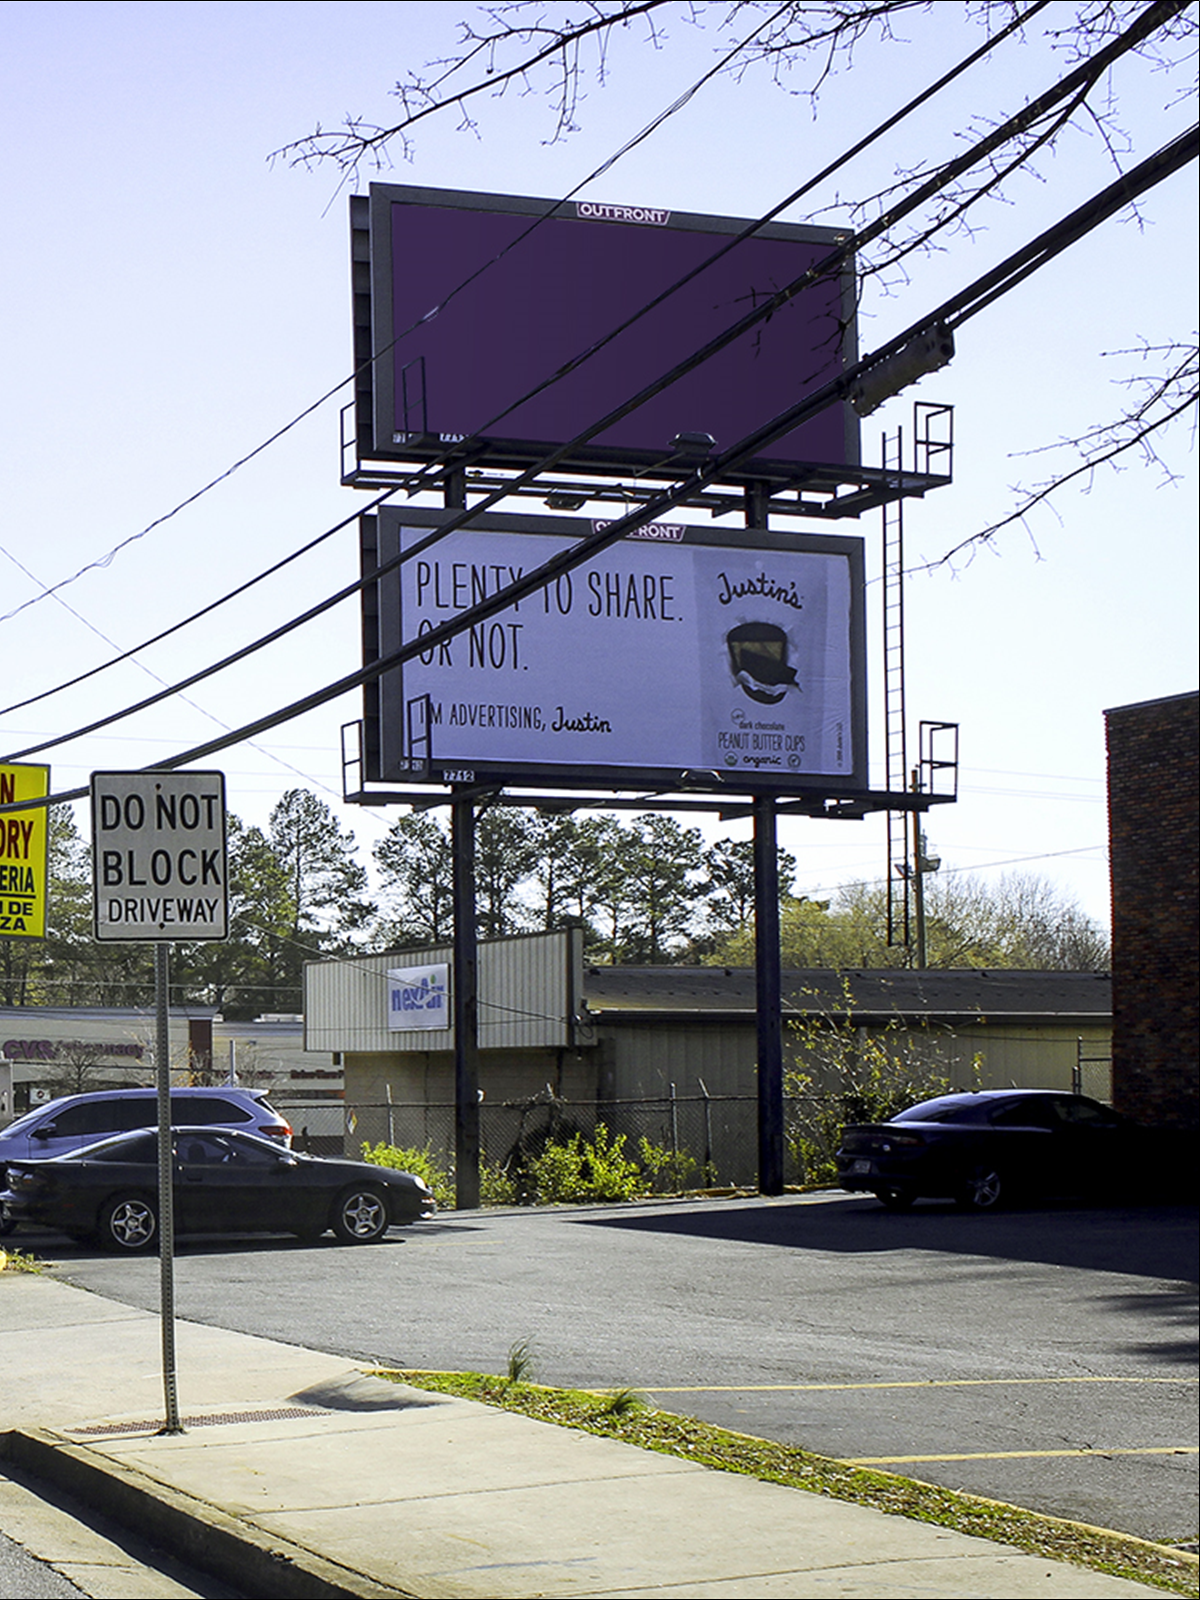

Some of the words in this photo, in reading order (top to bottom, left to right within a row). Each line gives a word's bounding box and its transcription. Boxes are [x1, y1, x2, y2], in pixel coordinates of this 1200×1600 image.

[580, 203, 665, 222] OUTFRONT
[595, 520, 681, 538] ORONT
[587, 571, 684, 622] SHARE.
[717, 572, 803, 610] Justin's
[469, 622, 529, 671] NOT.
[419, 701, 443, 725] IM
[449, 702, 546, 732] ADVERTISING,
[551, 706, 613, 733] Justin
[717, 731, 750, 750] PEANUT
[753, 733, 783, 752] BUTTER
[785, 735, 806, 753] CUPS
[742, 755, 782, 768] organic
[101, 793, 145, 831] DO
[156, 793, 219, 831] NOT
[103, 849, 221, 886] BLOCK
[8, 901, 33, 916] DE
[108, 898, 219, 923] DRIVEWAY
